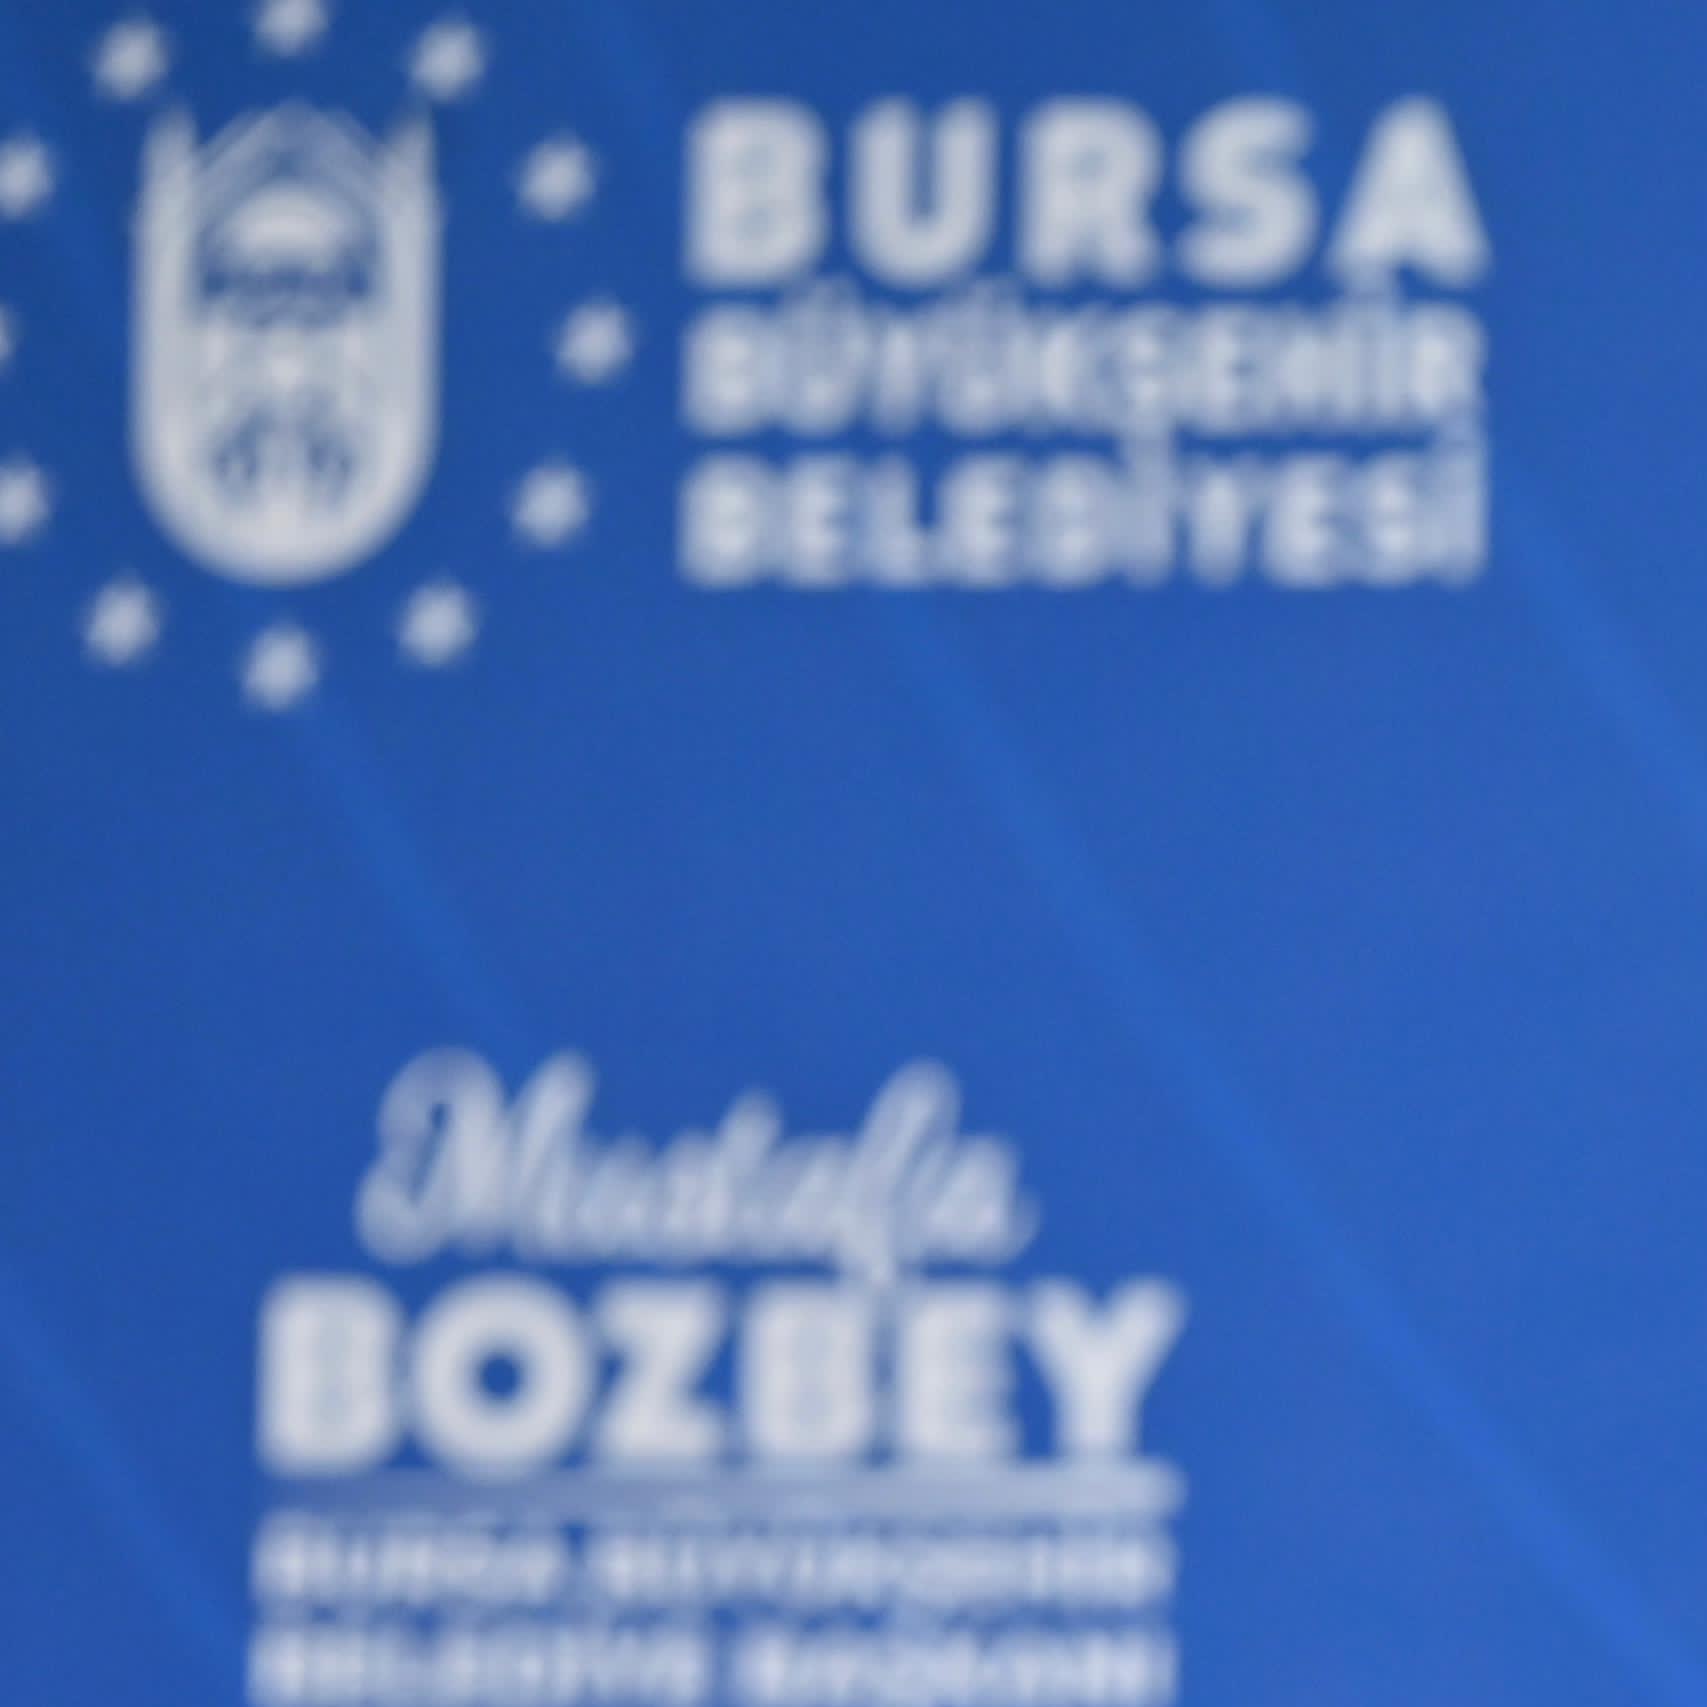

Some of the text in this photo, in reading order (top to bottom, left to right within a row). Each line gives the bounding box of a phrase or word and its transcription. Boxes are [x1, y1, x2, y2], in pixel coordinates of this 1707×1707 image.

[684, 95, 1490, 292] BURSA
[355, 1045, 1040, 1285] Mustafa
[255, 1270, 1188, 1478] BOZBEY
